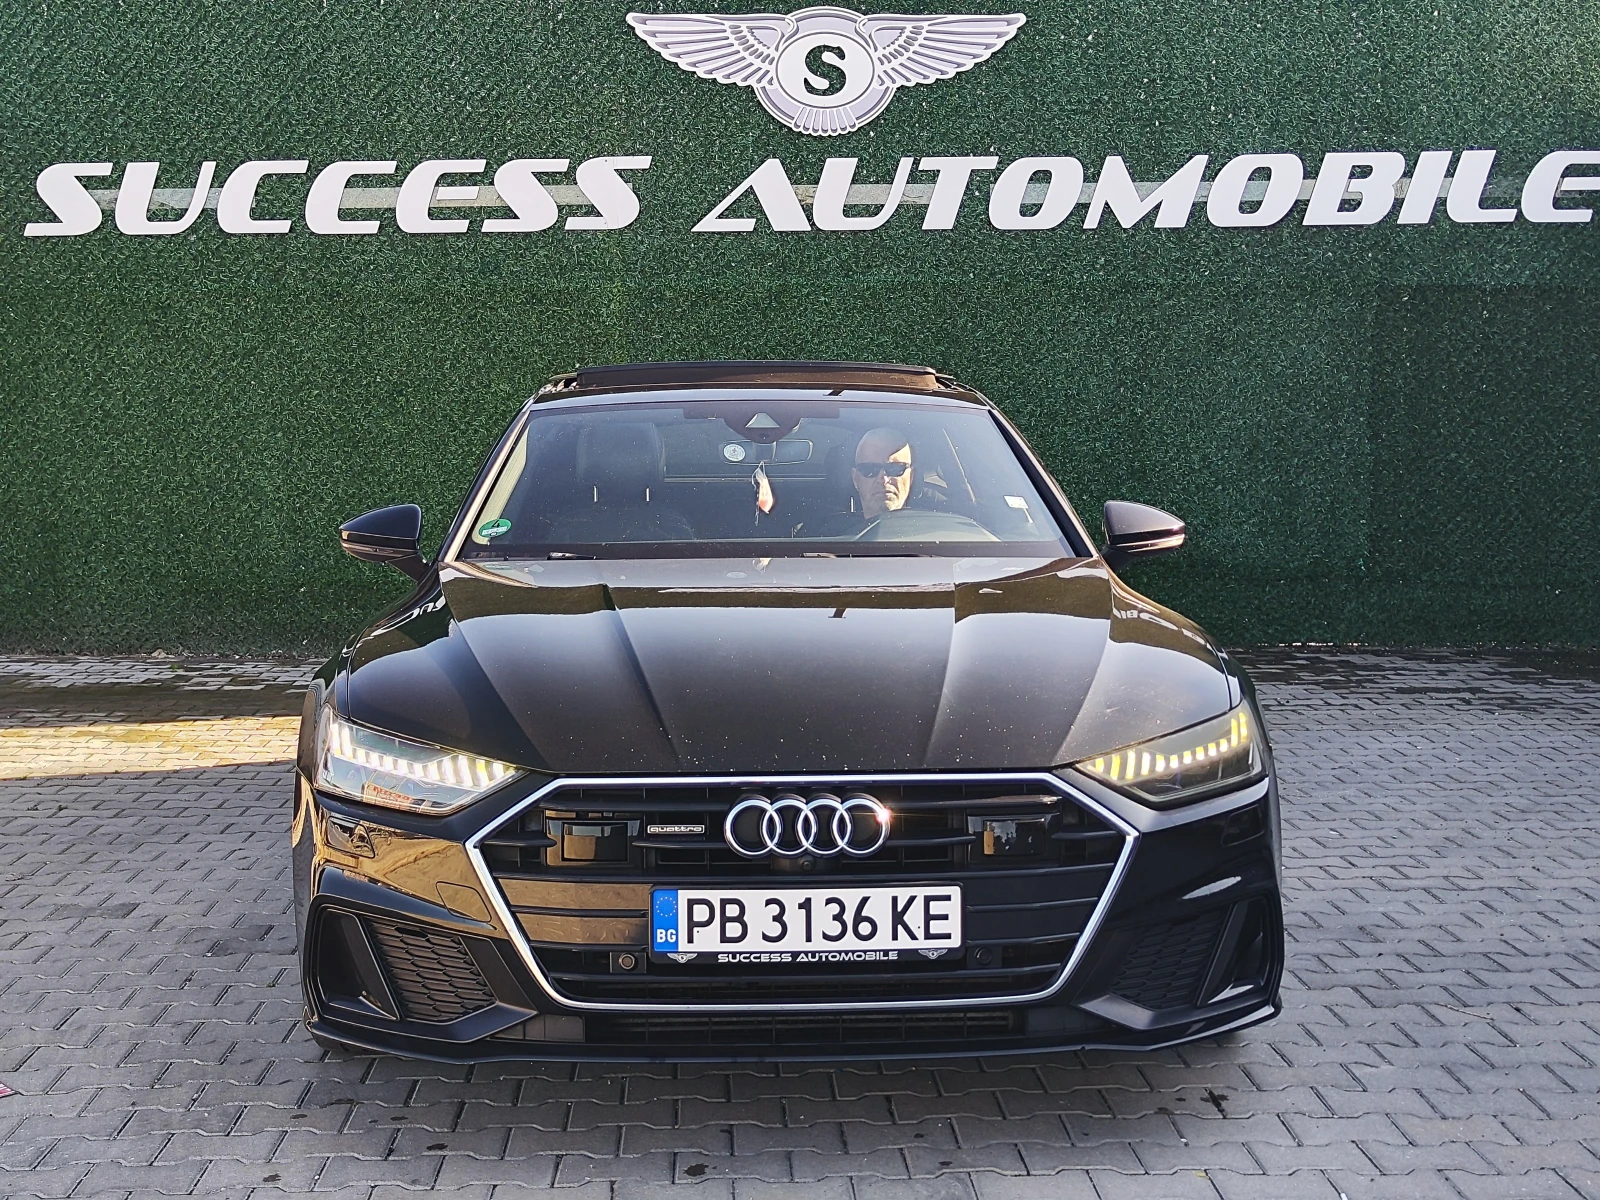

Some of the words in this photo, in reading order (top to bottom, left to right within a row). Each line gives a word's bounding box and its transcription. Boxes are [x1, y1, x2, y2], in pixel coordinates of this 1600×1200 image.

[804, 44, 846, 96] S
[24, 155, 653, 236] SUCCESS
[691, 149, 1600, 233] AUTOMOBILE
[649, 825, 703, 833] quattro
[687, 897, 749, 944] PB
[762, 896, 878, 943] 3136
[890, 894, 952, 941] KE
[656, 928, 676, 943] BG
[717, 953, 792, 963] SUCCESS
[795, 950, 899, 962] AUTOMOBILE
